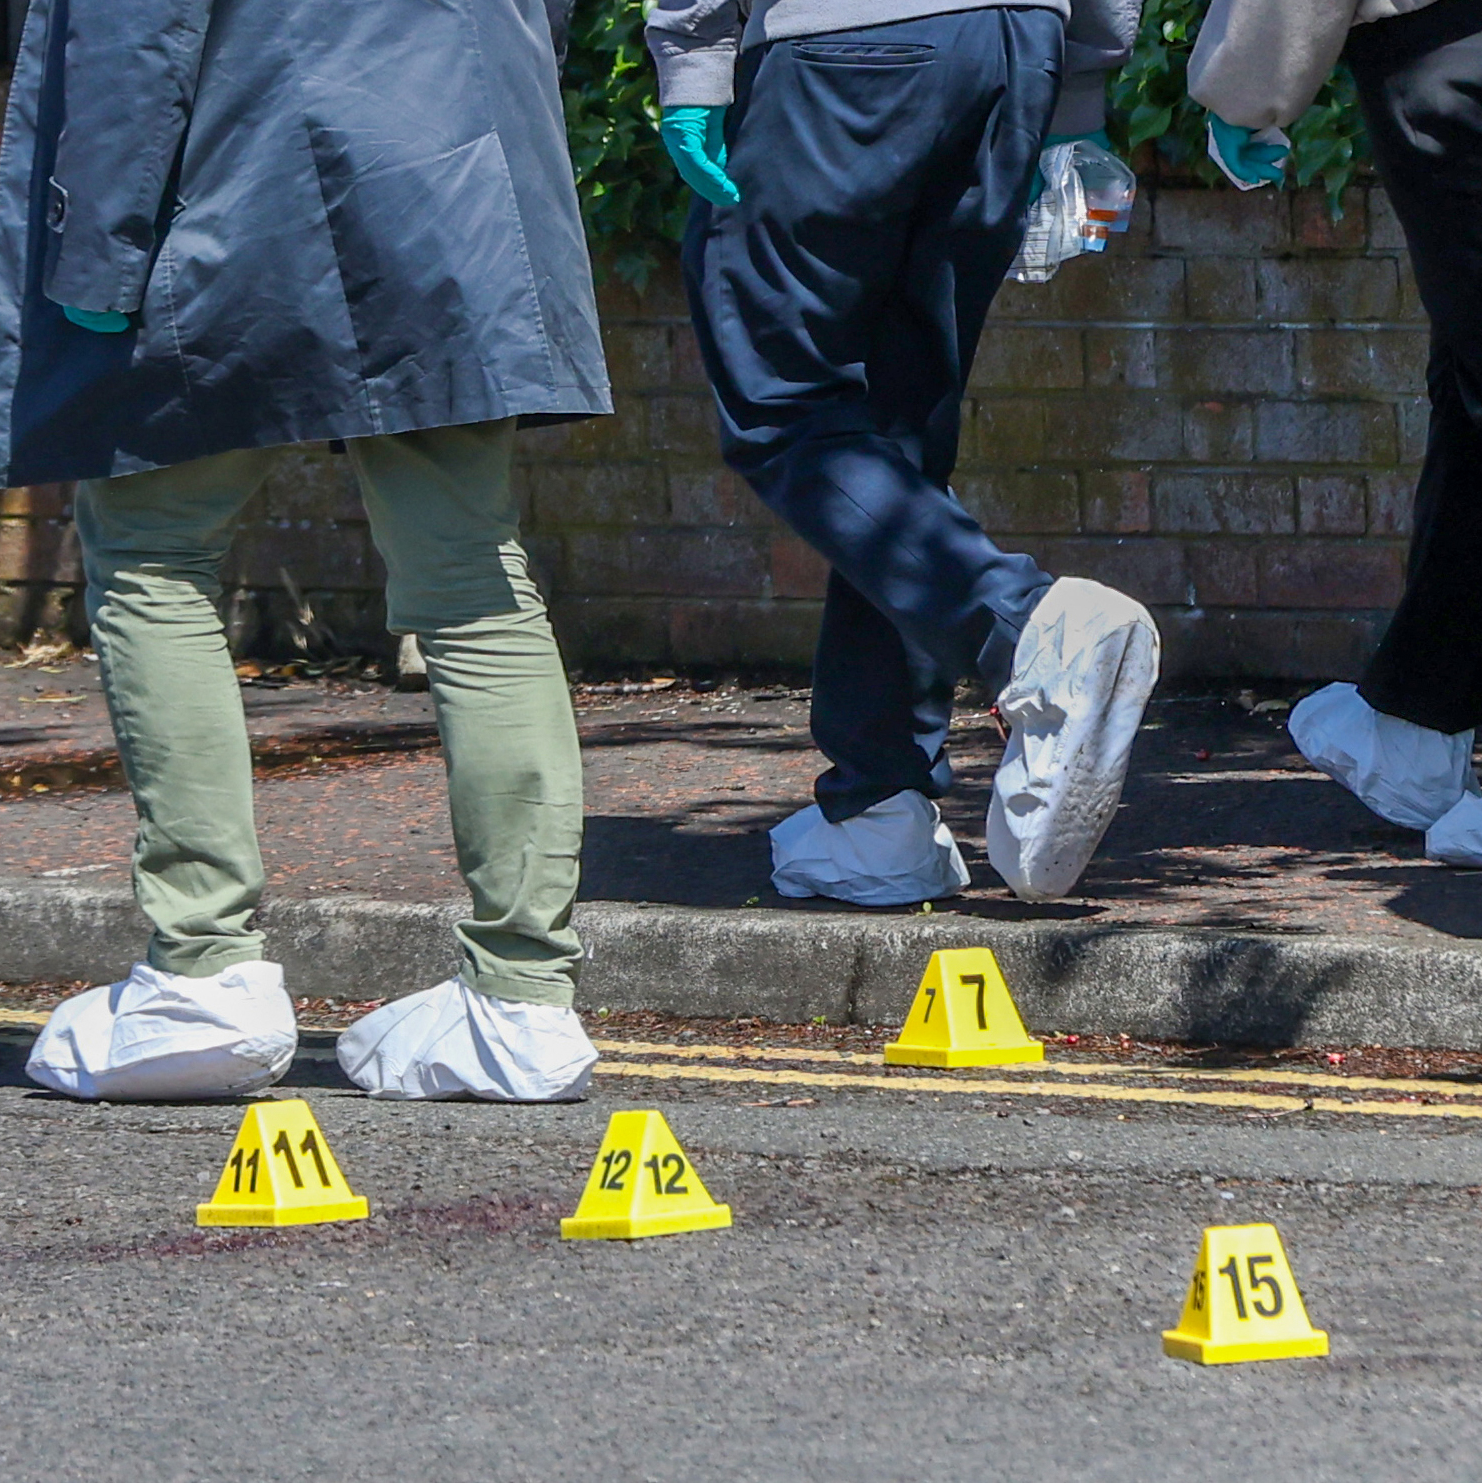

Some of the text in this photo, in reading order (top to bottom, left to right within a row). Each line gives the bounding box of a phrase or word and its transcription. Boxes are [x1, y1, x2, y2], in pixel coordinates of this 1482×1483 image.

[923, 988, 936, 1023] 7
[959, 974, 987, 1030] 7
[230, 1148, 260, 1193] 11
[273, 1130, 332, 1188] 11
[599, 1149, 633, 1191] 12
[643, 1153, 689, 1195] 12
[1218, 1254, 1283, 1320] 15
